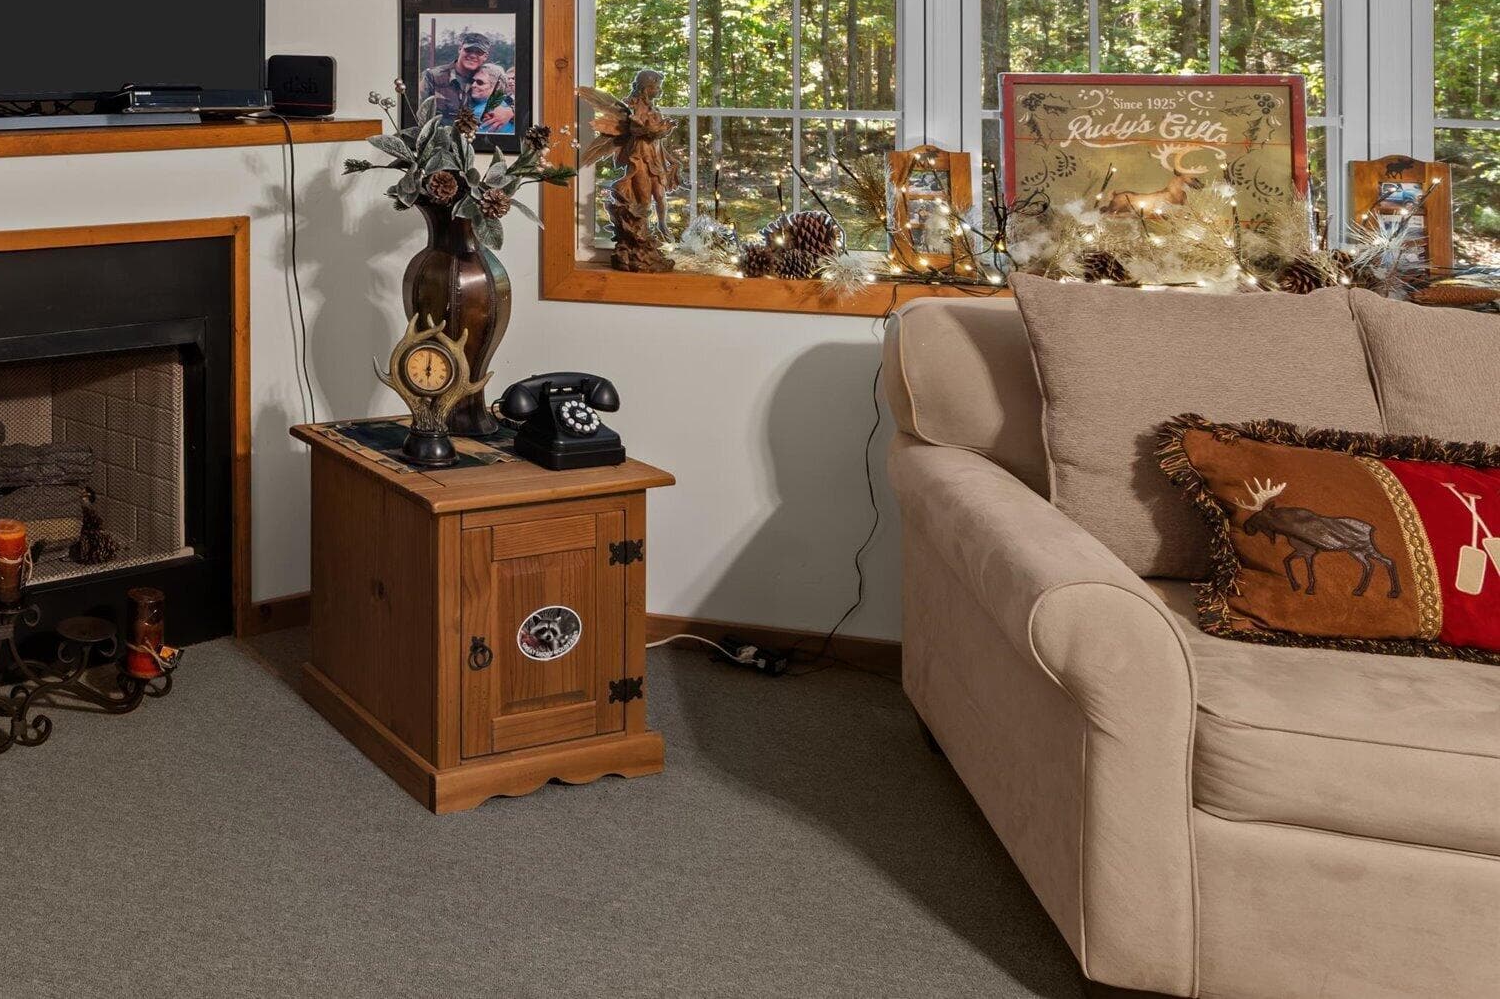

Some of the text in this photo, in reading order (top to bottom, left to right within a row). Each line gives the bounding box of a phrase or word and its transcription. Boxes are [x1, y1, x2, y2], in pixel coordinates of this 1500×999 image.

[1113, 97, 1177, 110] Since 1925
[1059, 111, 1229, 148] Rudy's Gifts
